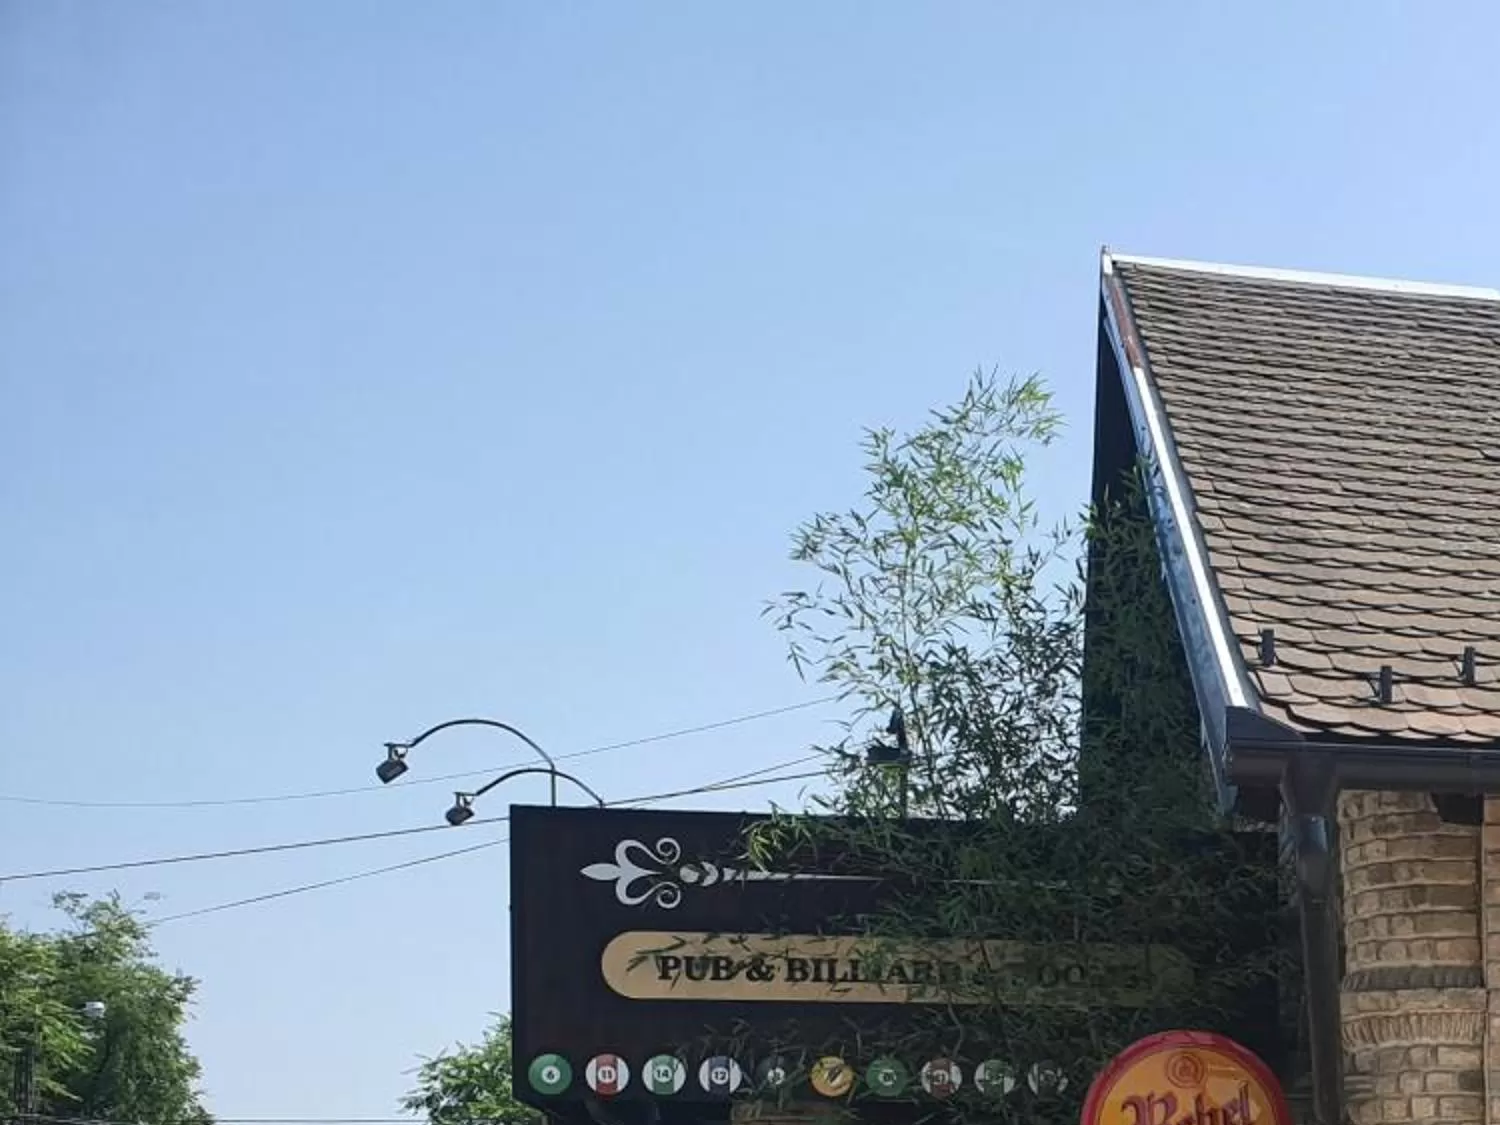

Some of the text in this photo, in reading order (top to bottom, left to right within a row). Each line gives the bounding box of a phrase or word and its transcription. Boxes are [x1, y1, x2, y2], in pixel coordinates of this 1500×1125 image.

[657, 954, 735, 982] PUB
[745, 953, 775, 983] &
[784, 956, 967, 987] BILLARD
